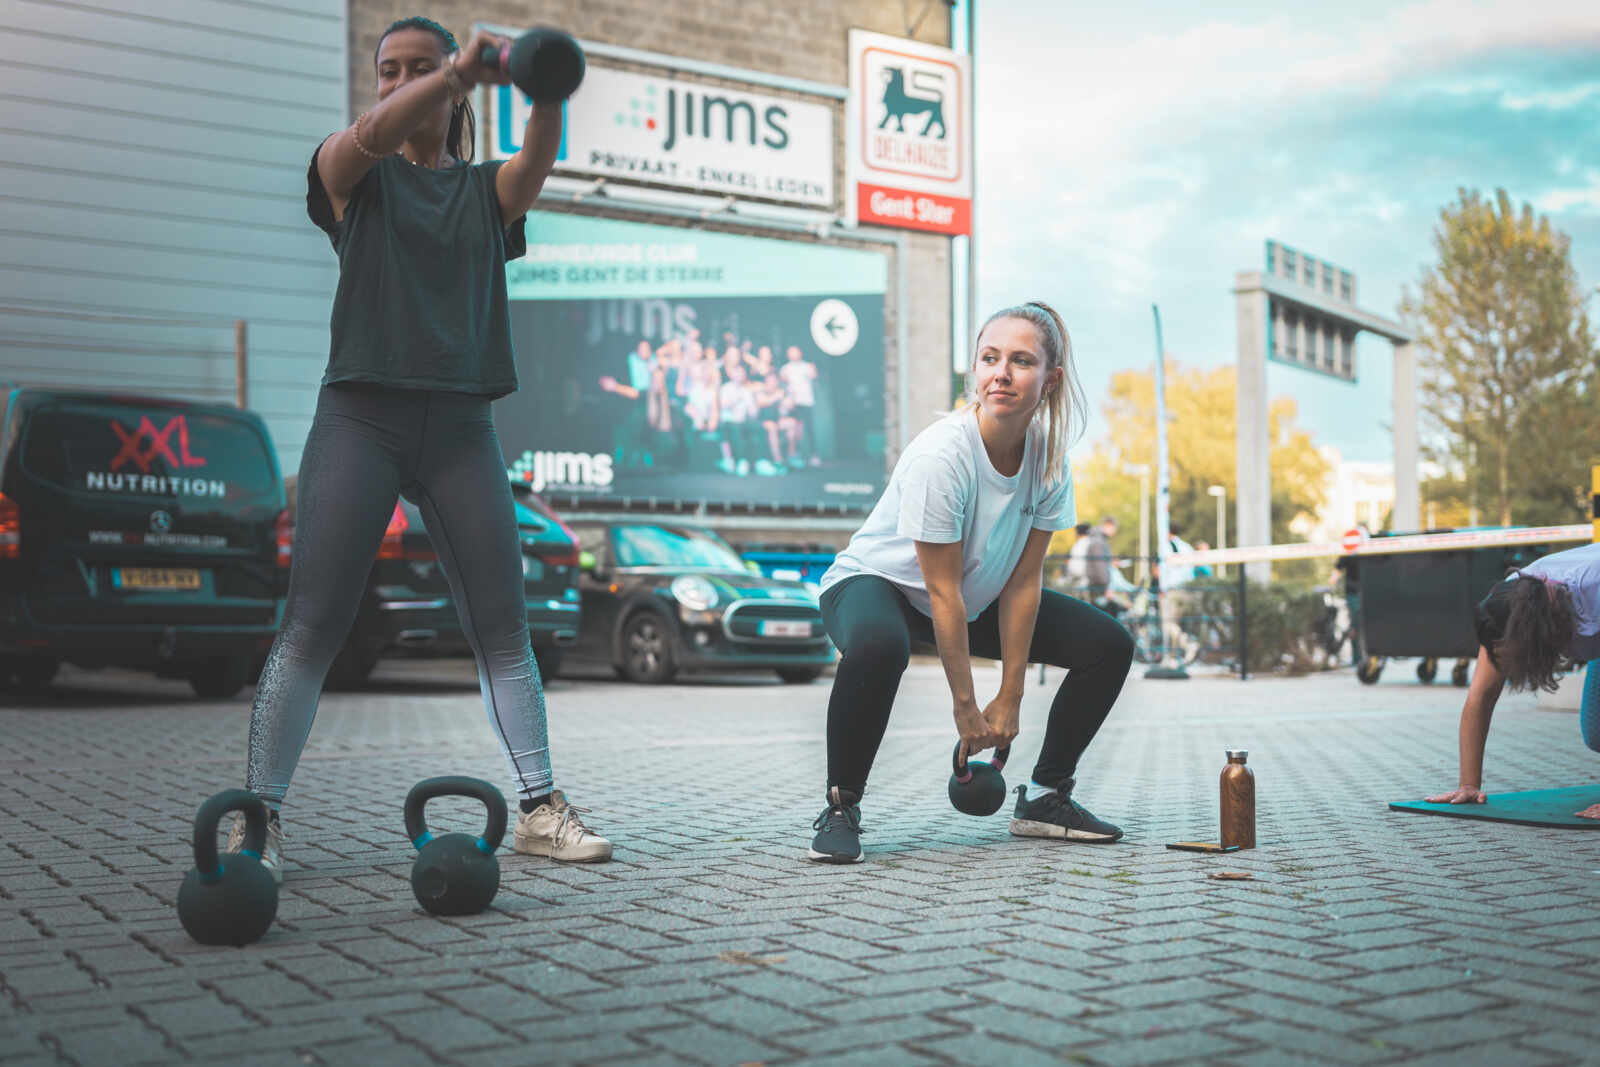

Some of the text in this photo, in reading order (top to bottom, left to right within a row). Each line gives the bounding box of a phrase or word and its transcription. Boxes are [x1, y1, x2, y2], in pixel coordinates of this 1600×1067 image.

[589, 150, 677, 178] PRIVAAT
[698, 166, 757, 189] ENKEL
[765, 178, 824, 197] LEDEN
[871, 191, 915, 220] Gent
[511, 266, 560, 284] JIMS
[565, 267, 618, 283] GENT
[624, 267, 650, 283] DE
[109, 415, 207, 472] XXL
[86, 471, 226, 496] NUTRITION
